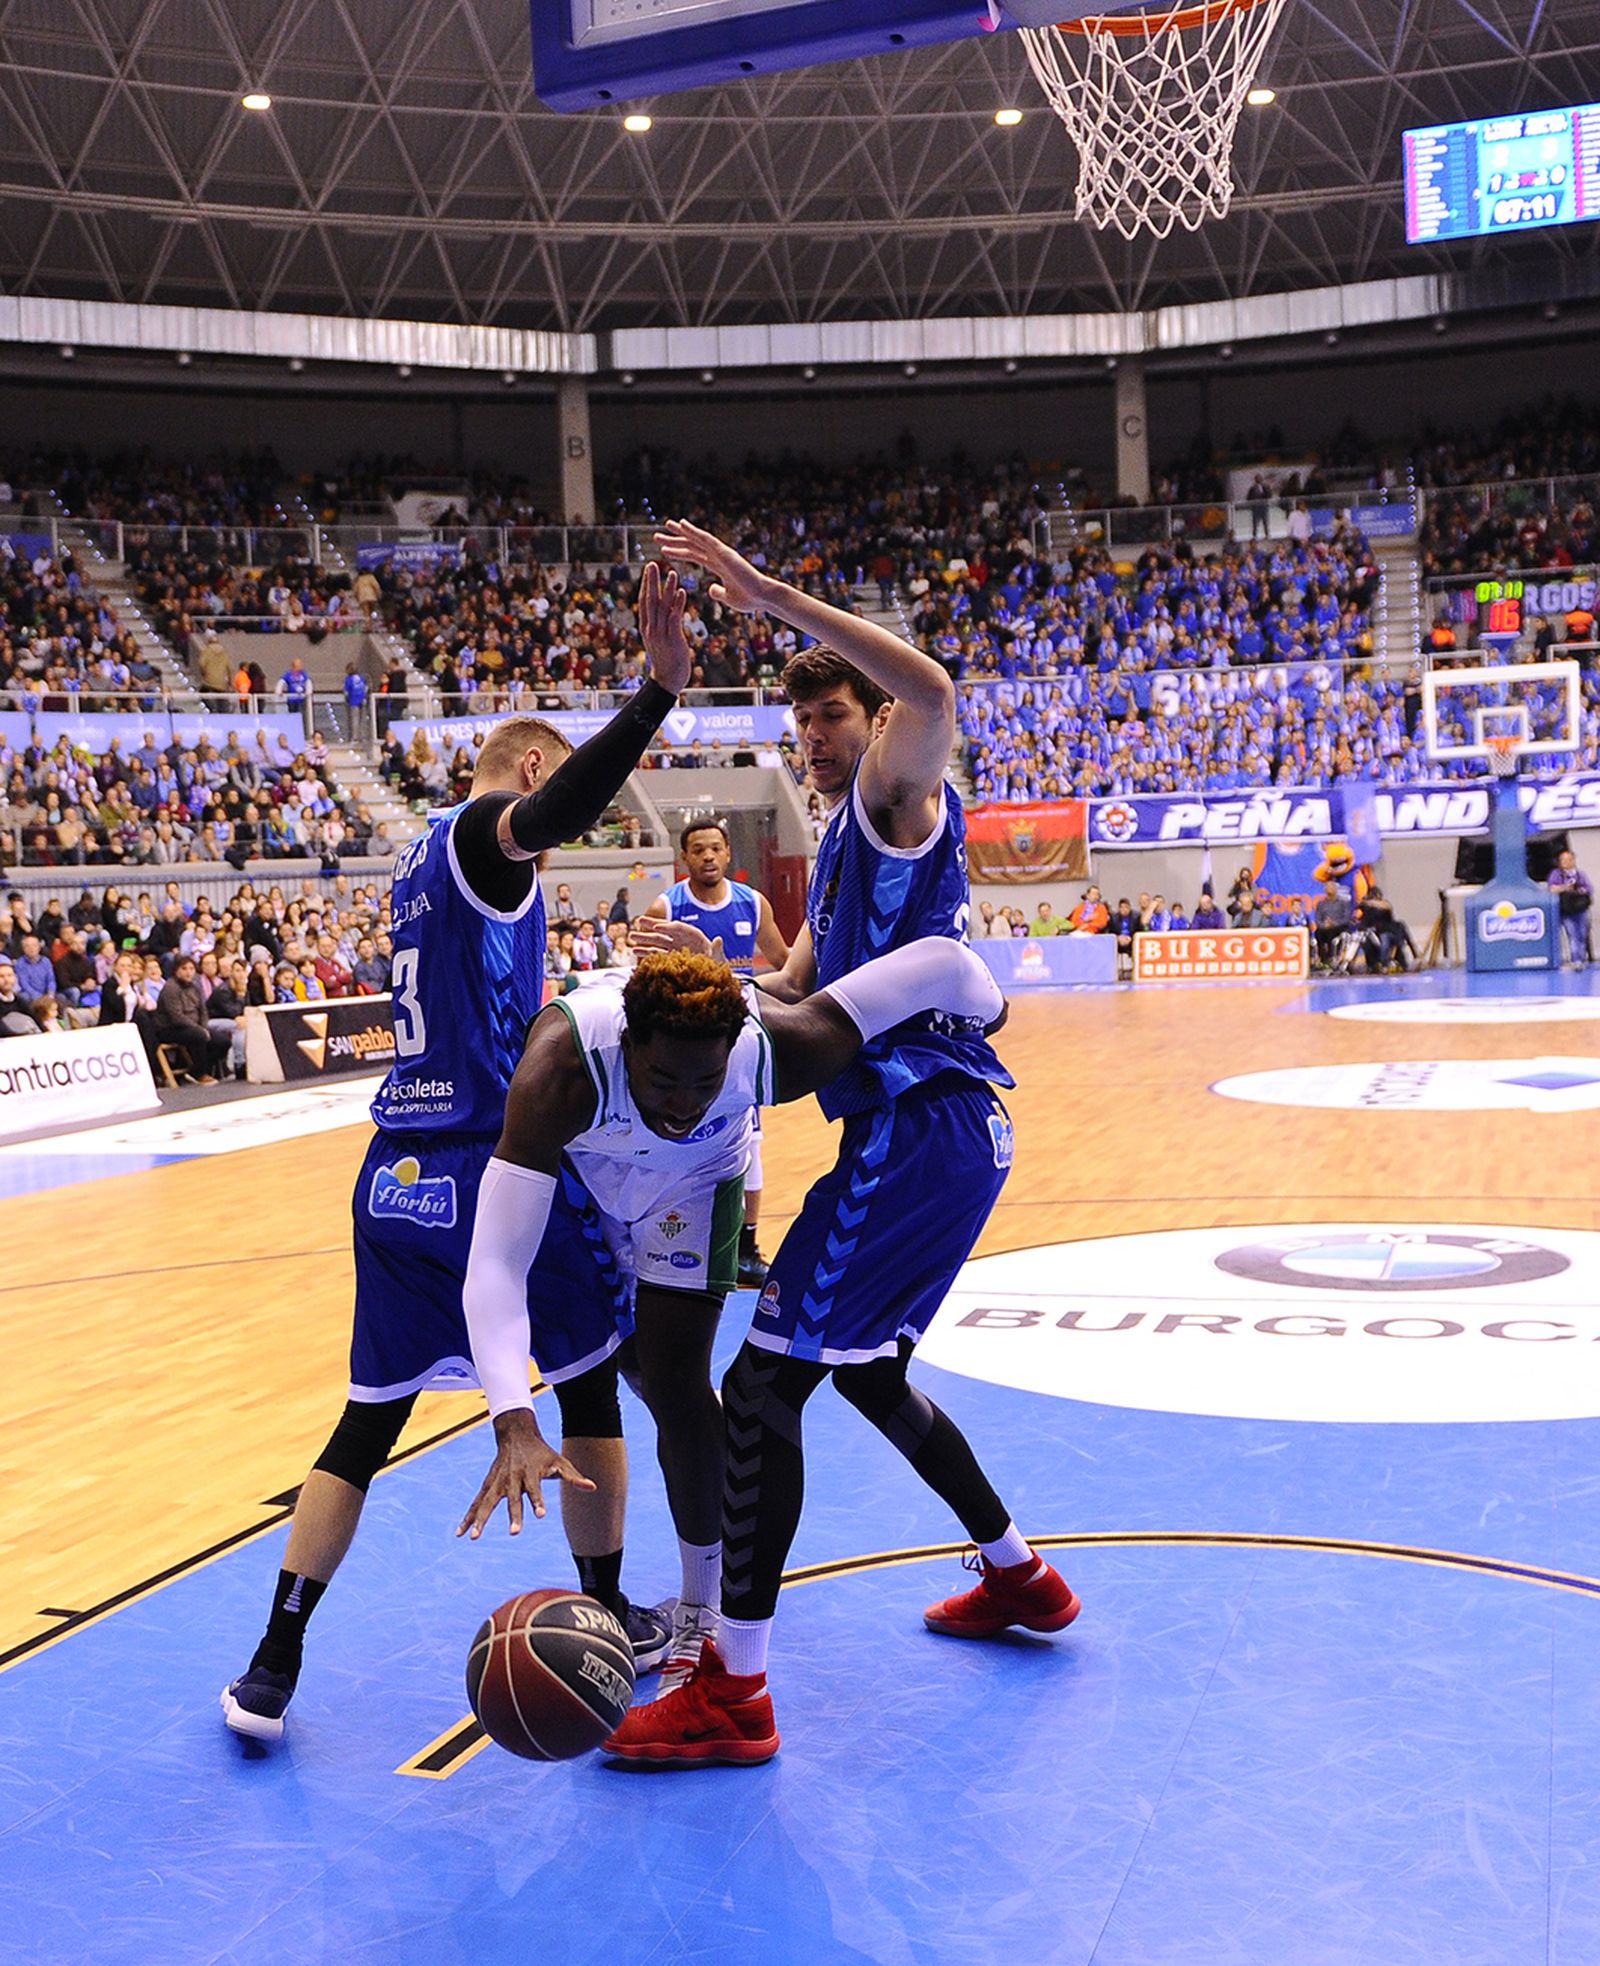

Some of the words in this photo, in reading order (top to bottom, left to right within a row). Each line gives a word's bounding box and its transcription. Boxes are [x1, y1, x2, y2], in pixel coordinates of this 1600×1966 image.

[1124, 415, 1142, 438] C
[567, 437, 585, 458] B
[702, 712, 753, 729] valora
[1158, 792, 1332, 841] PEÑA
[1143, 936, 1300, 960] BURGOS
[391, 948, 425, 1056] 3
[954, 1308, 1600, 1342] BURGOC
